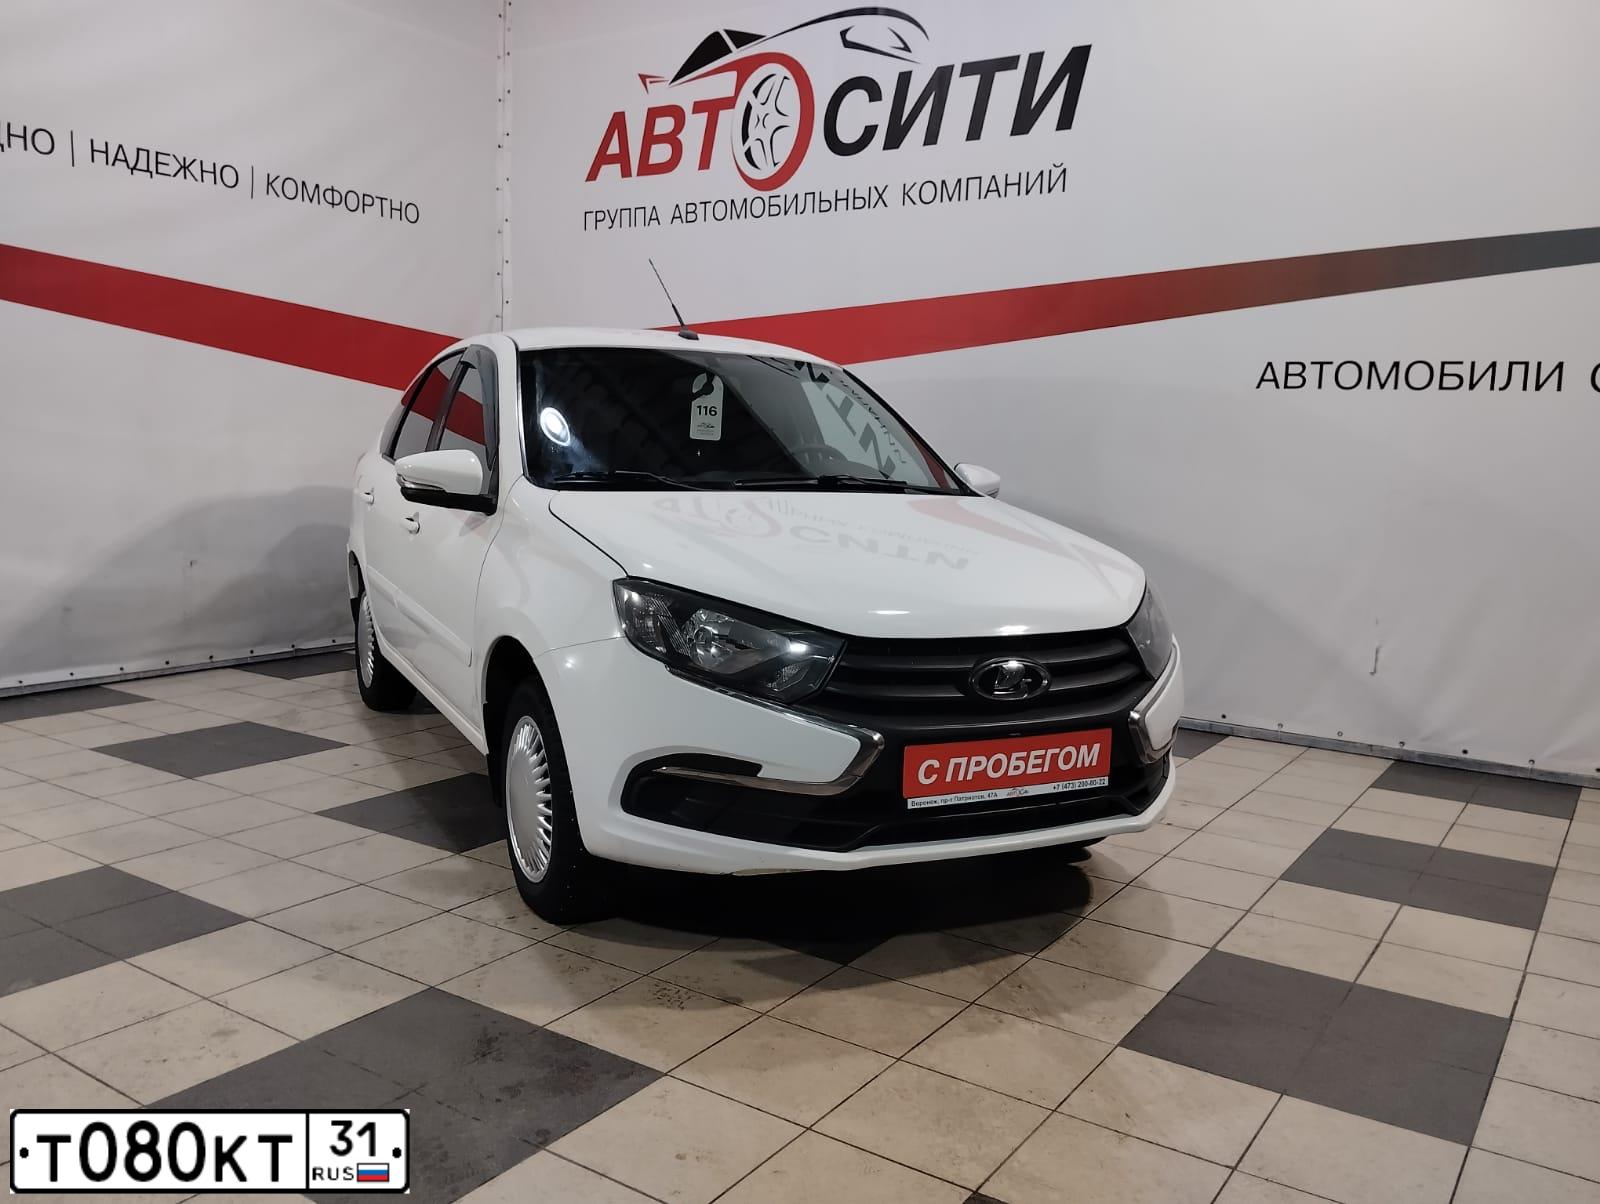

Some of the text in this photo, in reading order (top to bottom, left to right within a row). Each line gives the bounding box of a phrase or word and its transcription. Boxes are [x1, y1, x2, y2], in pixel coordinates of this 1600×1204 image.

[0, 121, 420, 224] НО НАДЕЖНО КОМФОРТНО
[583, 162, 1067, 232] ГРУППА АВТОМОБИЛЬНЫХ КОМПАНИЙ
[1255, 360, 1565, 392] АВТОМОБИЛИ
[696, 405, 718, 417] 116
[917, 743, 1101, 785] С ПРОБЕГОМ
